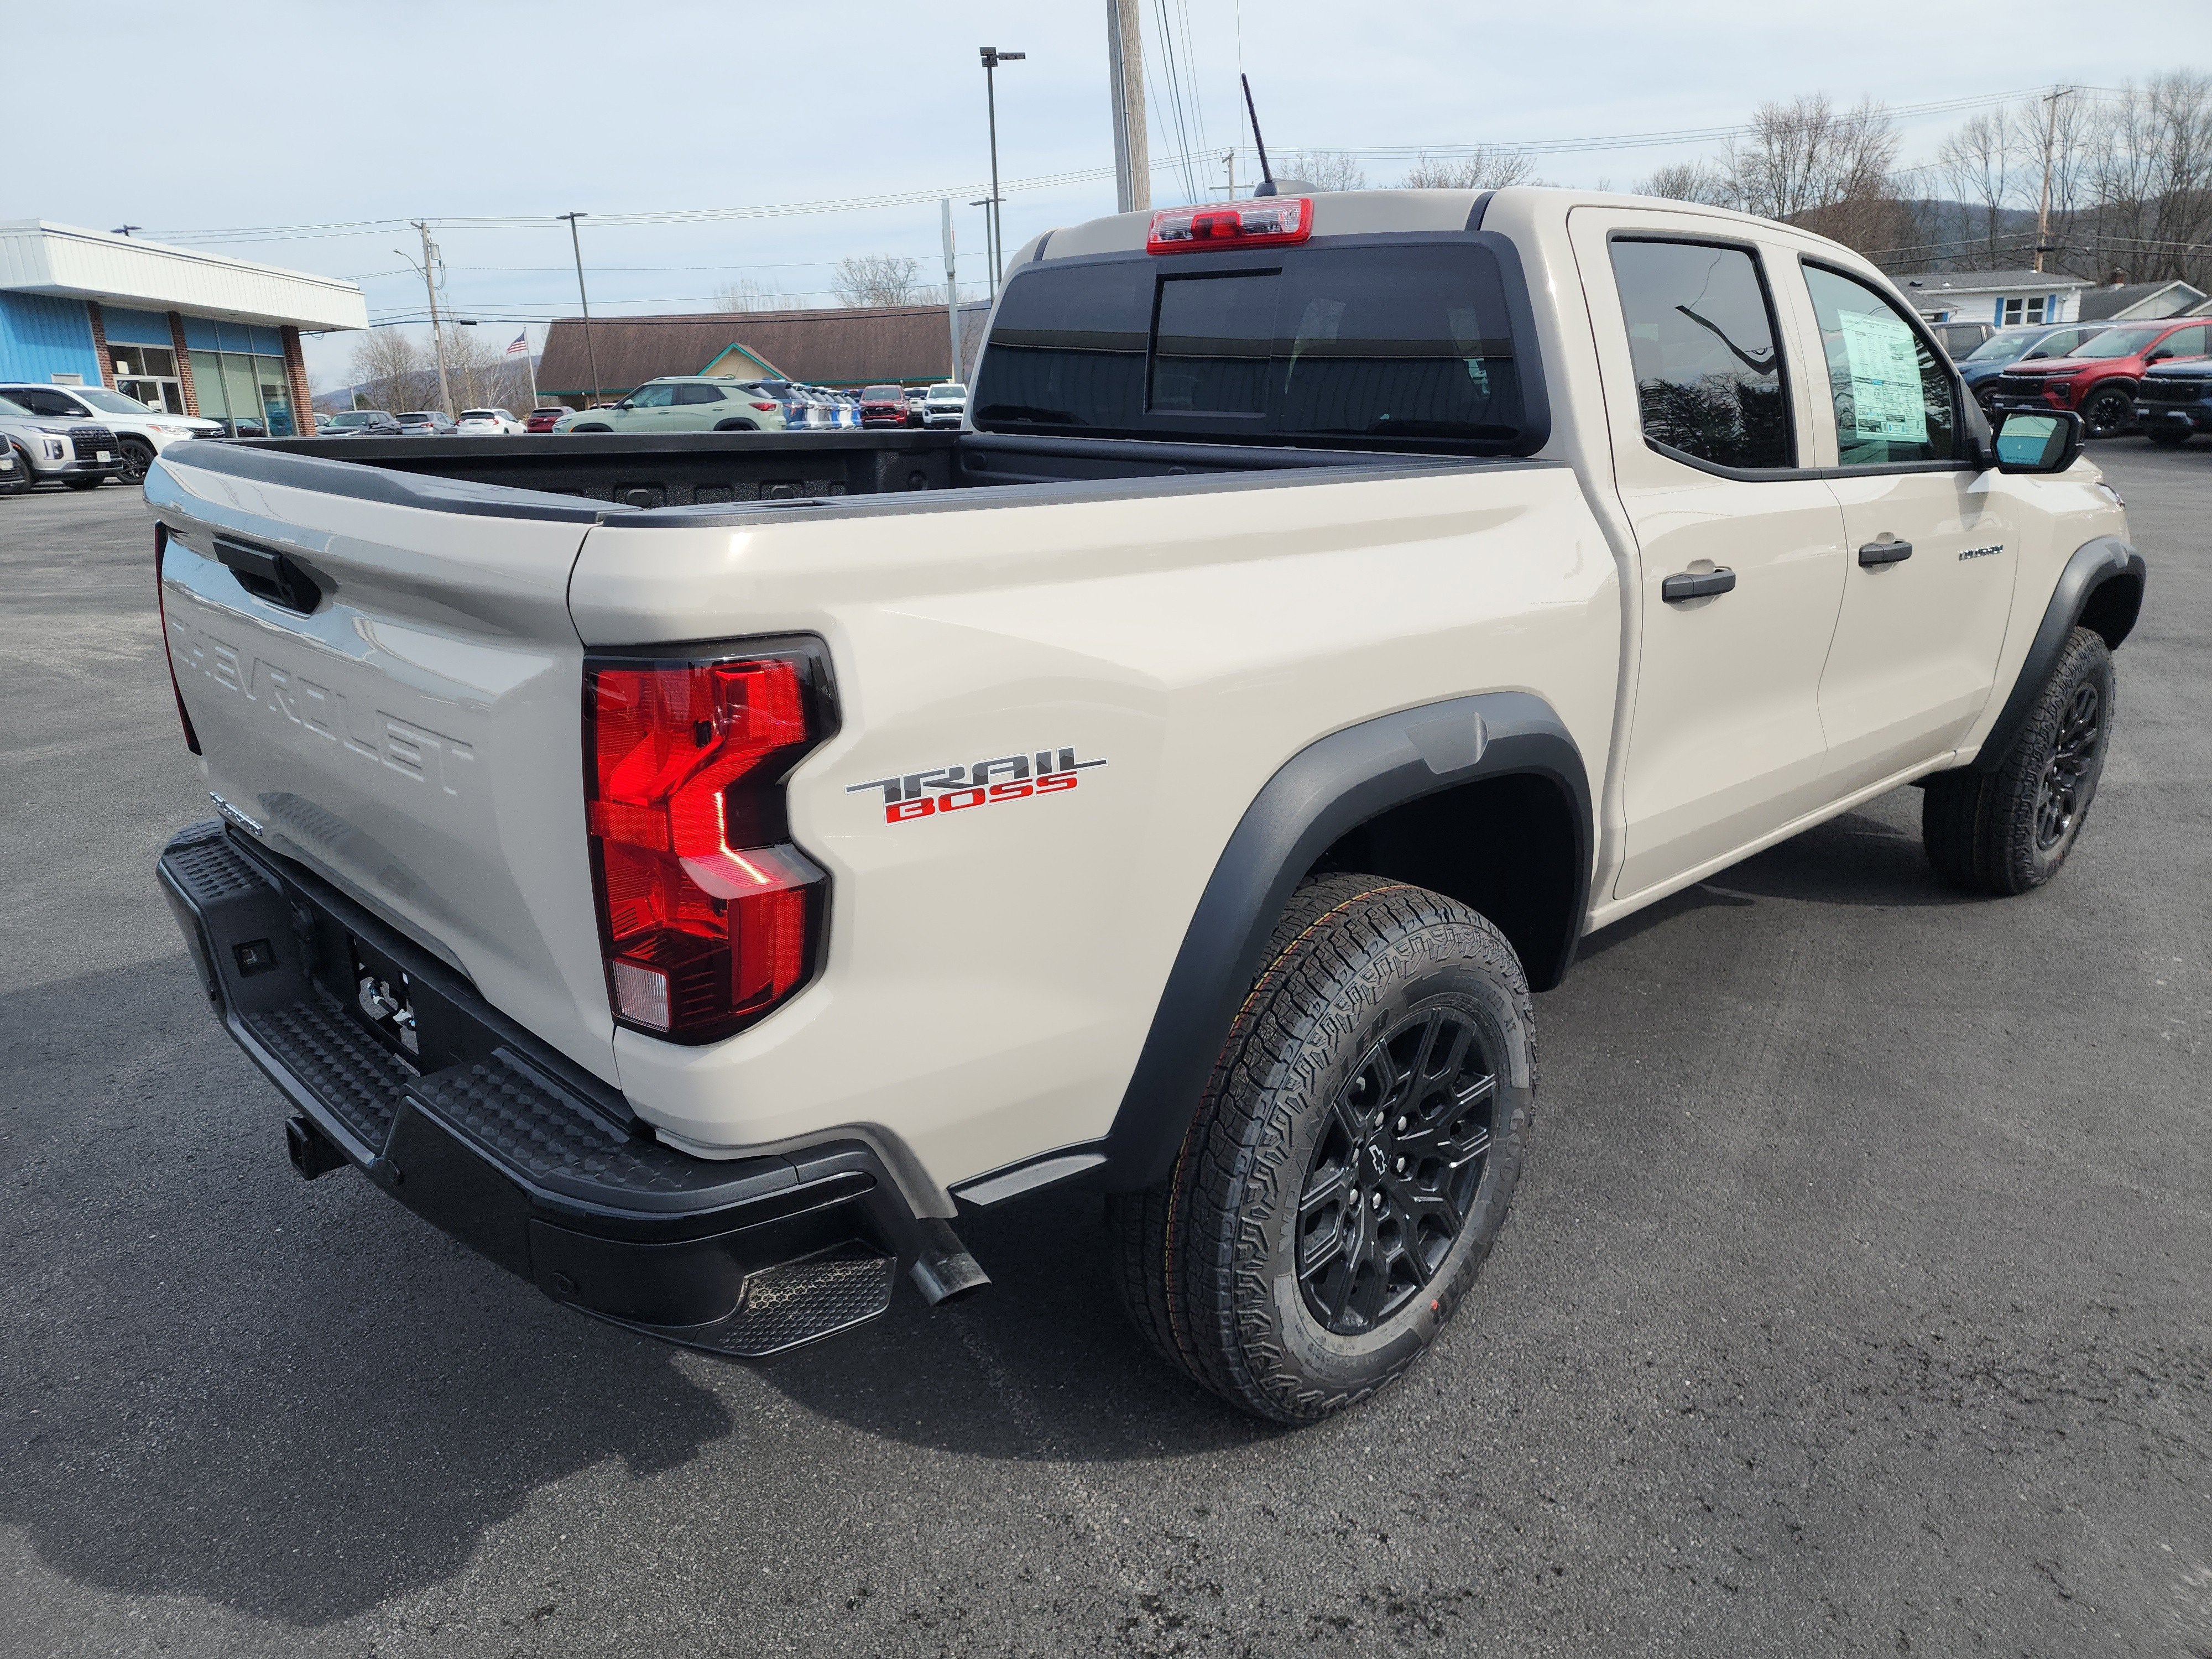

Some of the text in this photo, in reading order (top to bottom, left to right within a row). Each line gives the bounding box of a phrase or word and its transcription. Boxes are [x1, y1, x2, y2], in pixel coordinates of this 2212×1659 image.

[166, 611, 476, 796] CHEVROLET
[844, 745, 1108, 804] TRAIL
[885, 771, 1078, 826] BOSS
